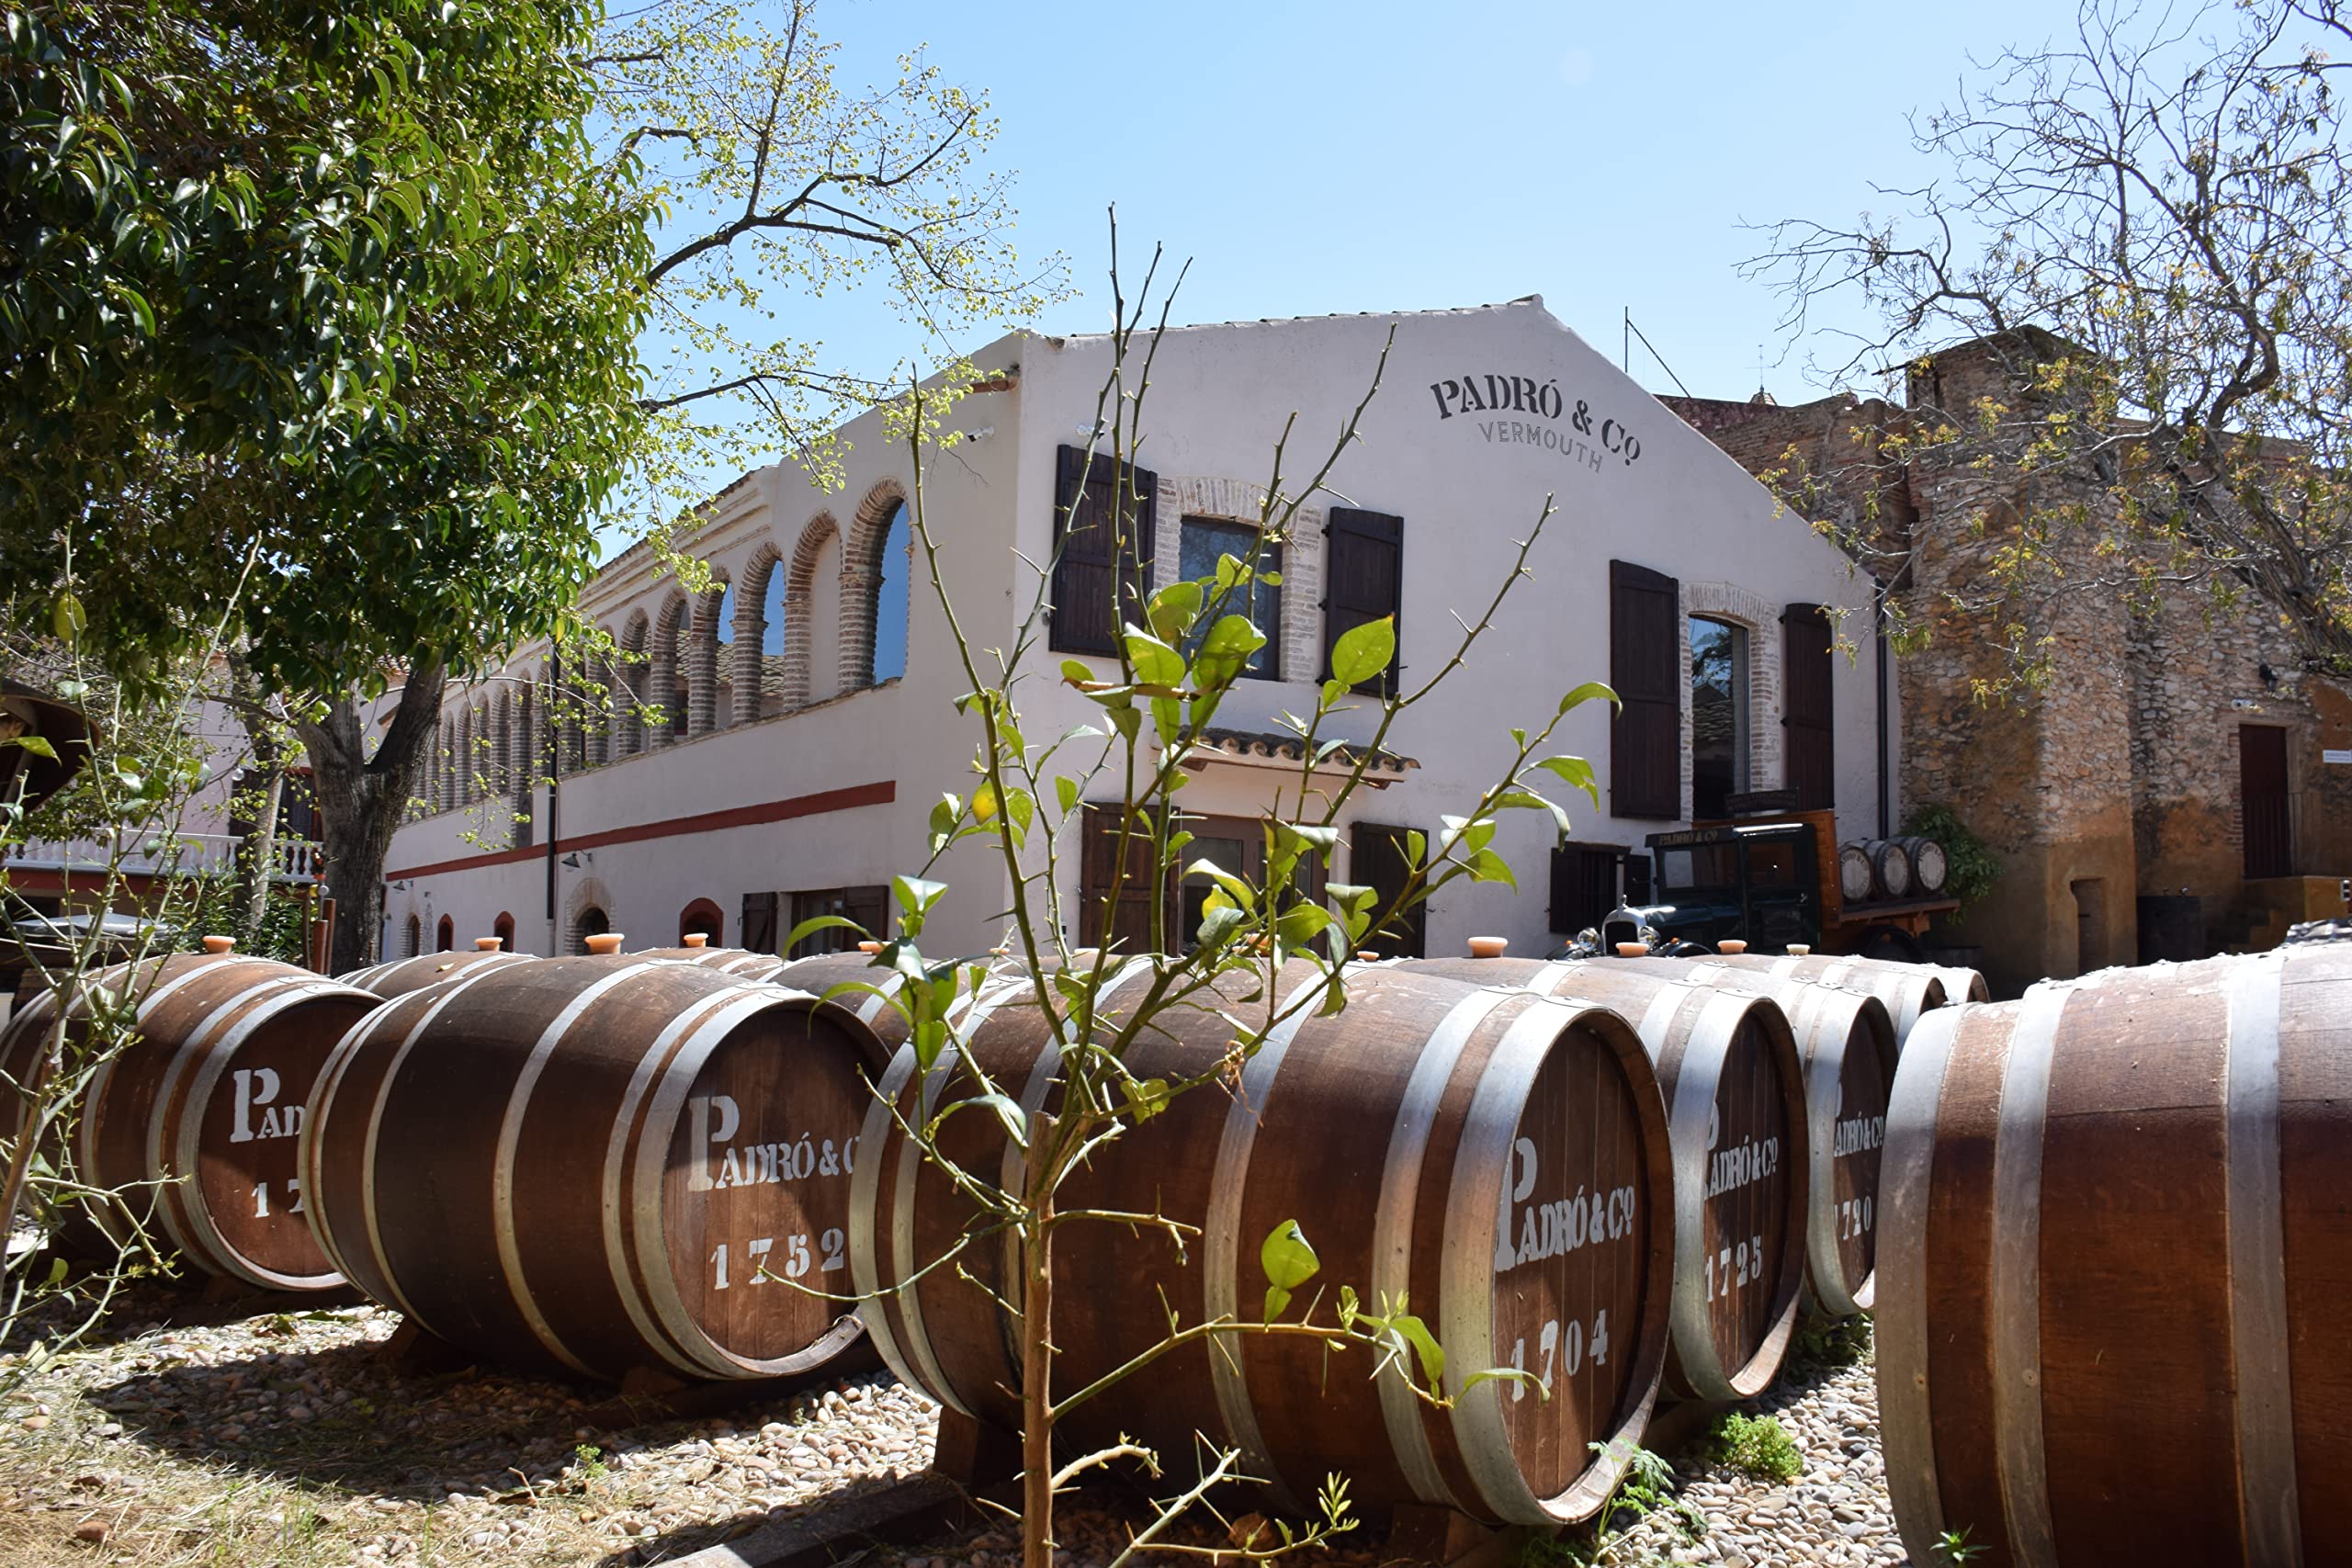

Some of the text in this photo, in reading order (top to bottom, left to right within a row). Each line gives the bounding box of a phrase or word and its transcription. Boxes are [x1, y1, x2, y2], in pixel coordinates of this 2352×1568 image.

[1430, 374, 1563, 420] PADRÓ
[1572, 399, 1593, 436] &
[1477, 421, 1603, 474] VERMOUTH
[230, 1067, 305, 1143] PAD
[709, 1227, 844, 1290] 1752
[1705, 1235, 1762, 1303] 1725
[1510, 1308, 1608, 1404] 1704
